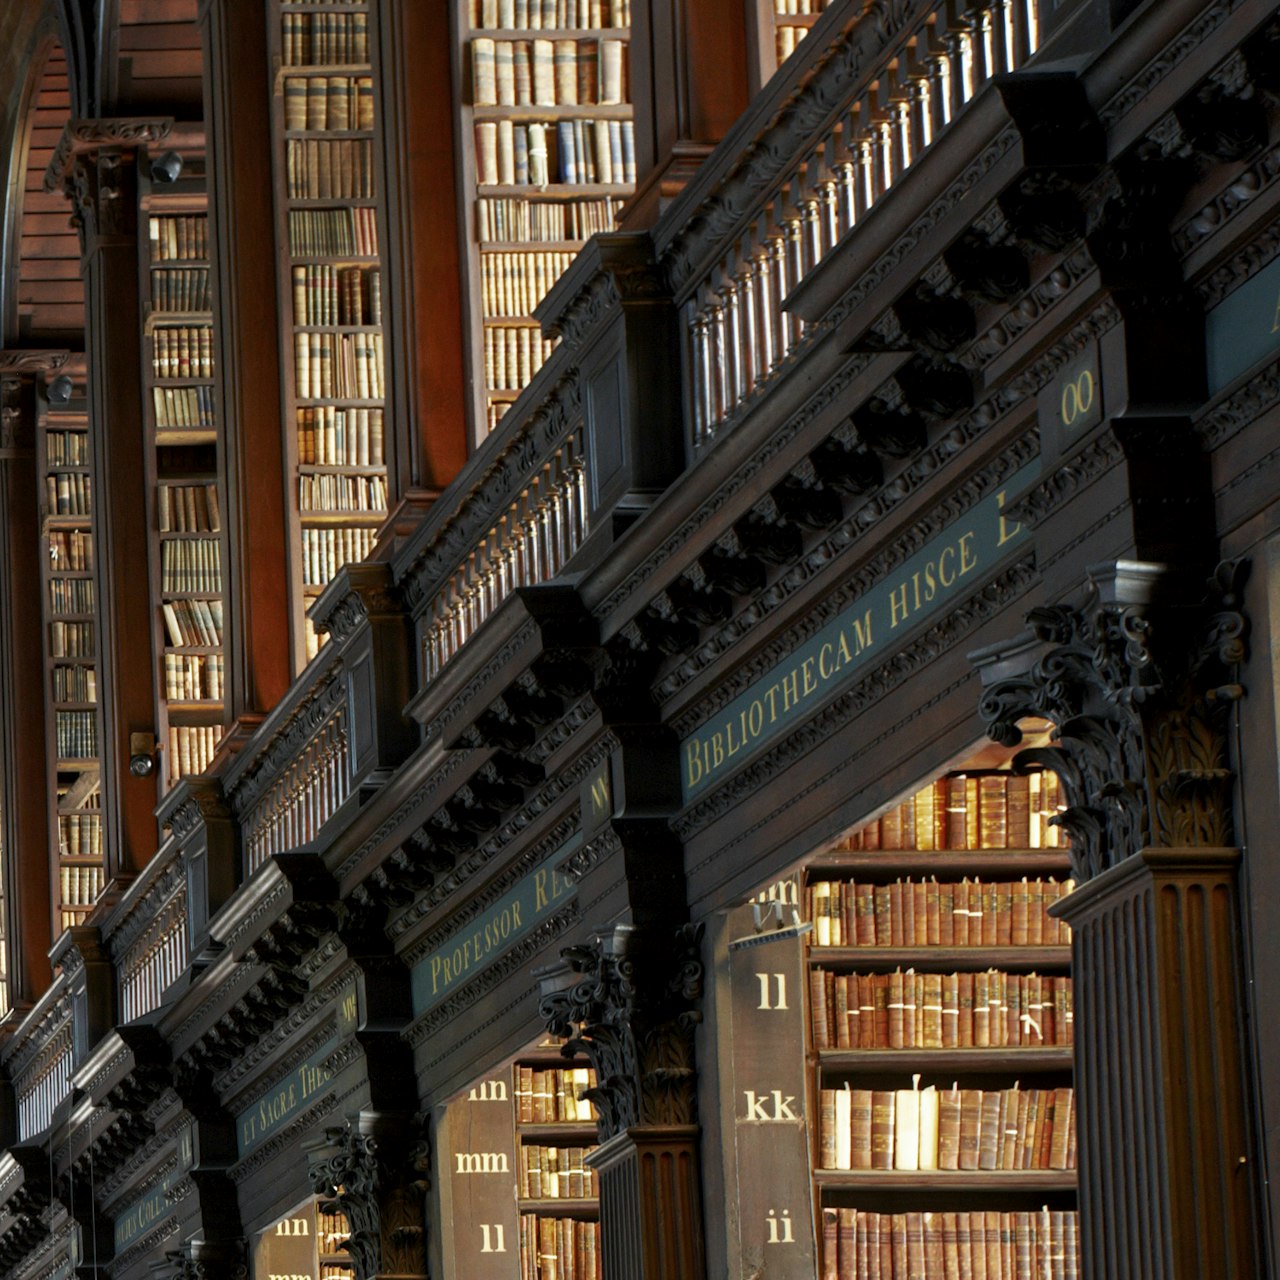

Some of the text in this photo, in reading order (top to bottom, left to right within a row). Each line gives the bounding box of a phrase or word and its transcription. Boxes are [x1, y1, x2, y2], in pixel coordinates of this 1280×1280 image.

[1060, 369, 1095, 426] OO
[685, 618, 874, 789] BIBLIOTHECAM
[887, 530, 978, 629] HISCE
[430, 899, 522, 996] PROFESSOR
[756, 973, 789, 1010] ll
[743, 1090, 799, 1123] kk
[455, 1152, 510, 1174] mm
[479, 1224, 507, 1253] ll
[765, 1209, 795, 1243] ii
